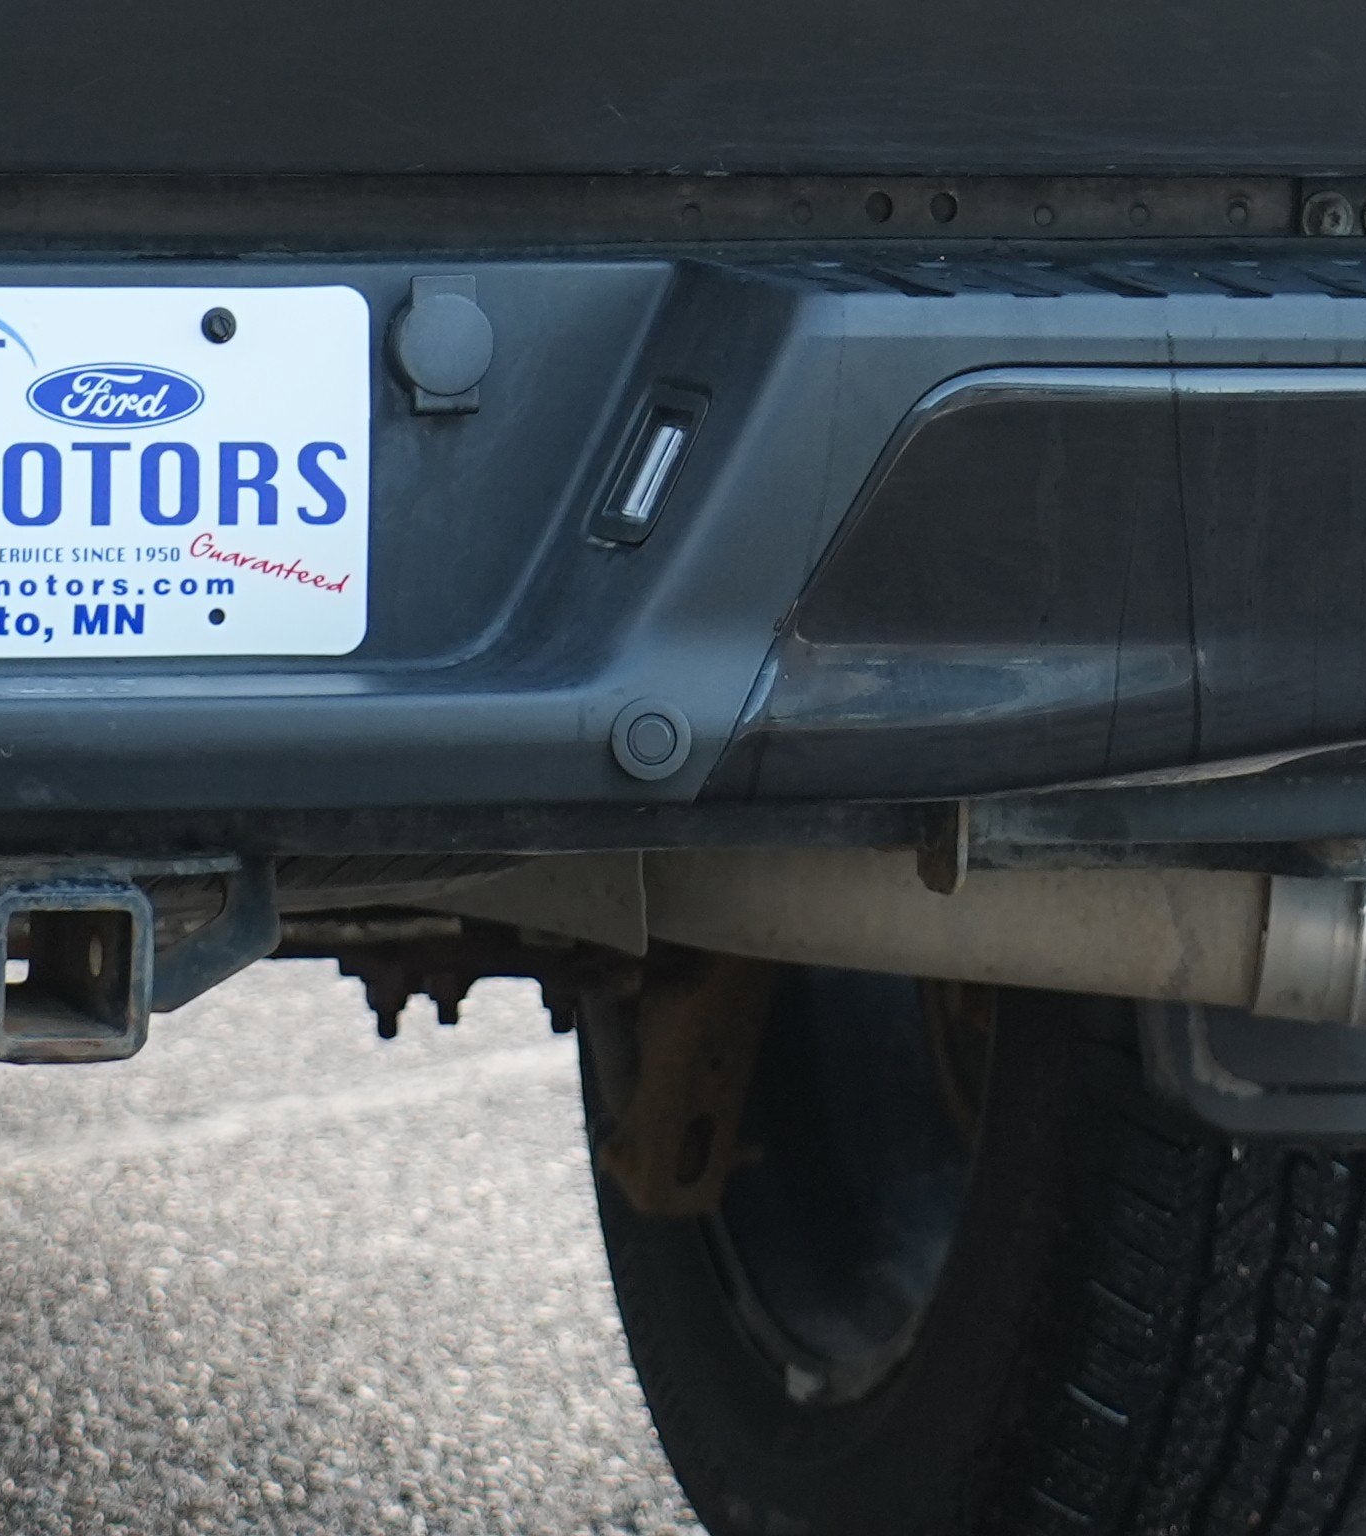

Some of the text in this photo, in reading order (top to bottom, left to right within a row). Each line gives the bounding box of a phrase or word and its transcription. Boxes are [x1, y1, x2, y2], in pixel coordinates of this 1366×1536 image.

[61, 371, 169, 418] Ford
[72, 547, 125, 562] SINCE
[135, 547, 180, 562] 1950
[189, 533, 350, 594] Guaranteed
[73, 604, 145, 635] MN
